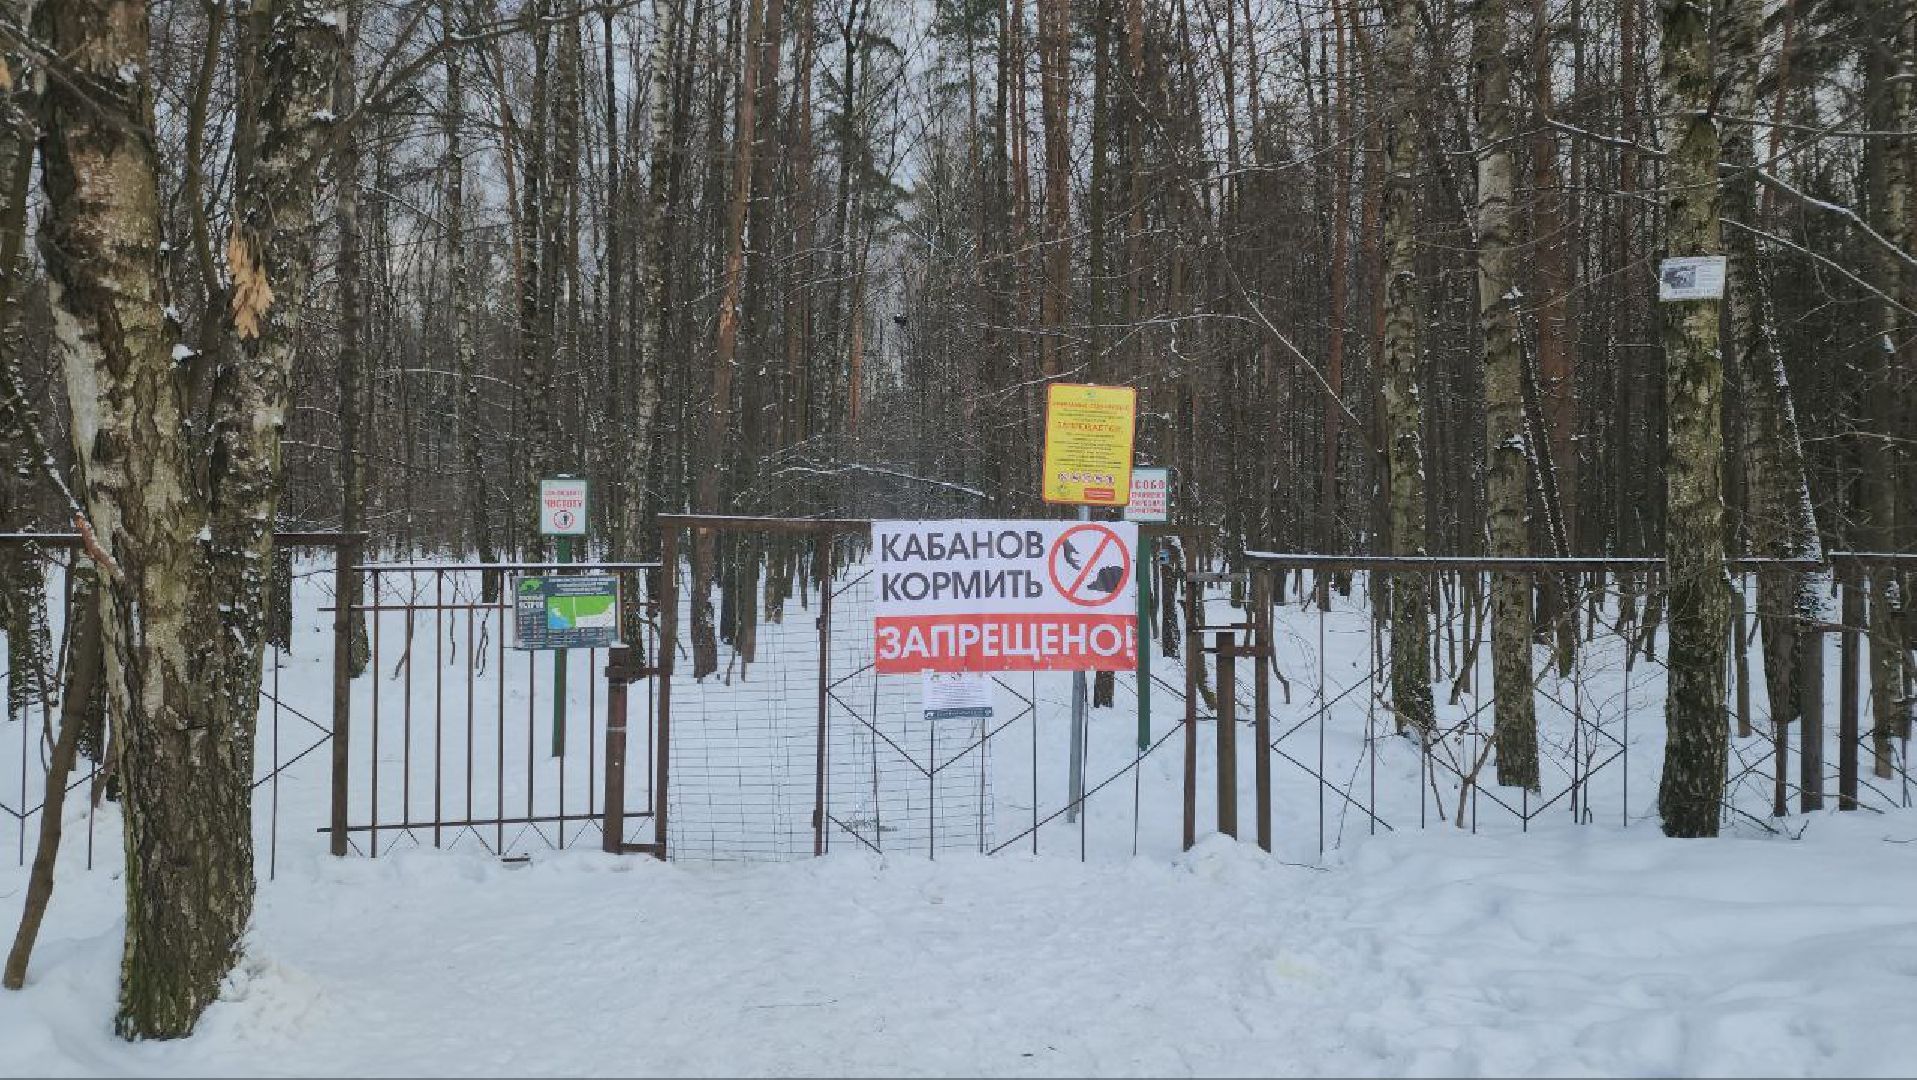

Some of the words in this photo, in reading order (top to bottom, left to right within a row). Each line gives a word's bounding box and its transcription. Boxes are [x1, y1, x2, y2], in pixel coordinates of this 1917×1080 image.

[881, 530, 1044, 562] КАБАНОВ
[882, 570, 1043, 602] КОРМИТЬ
[879, 622, 1135, 660] ЗАПРЕЩЕНО!
